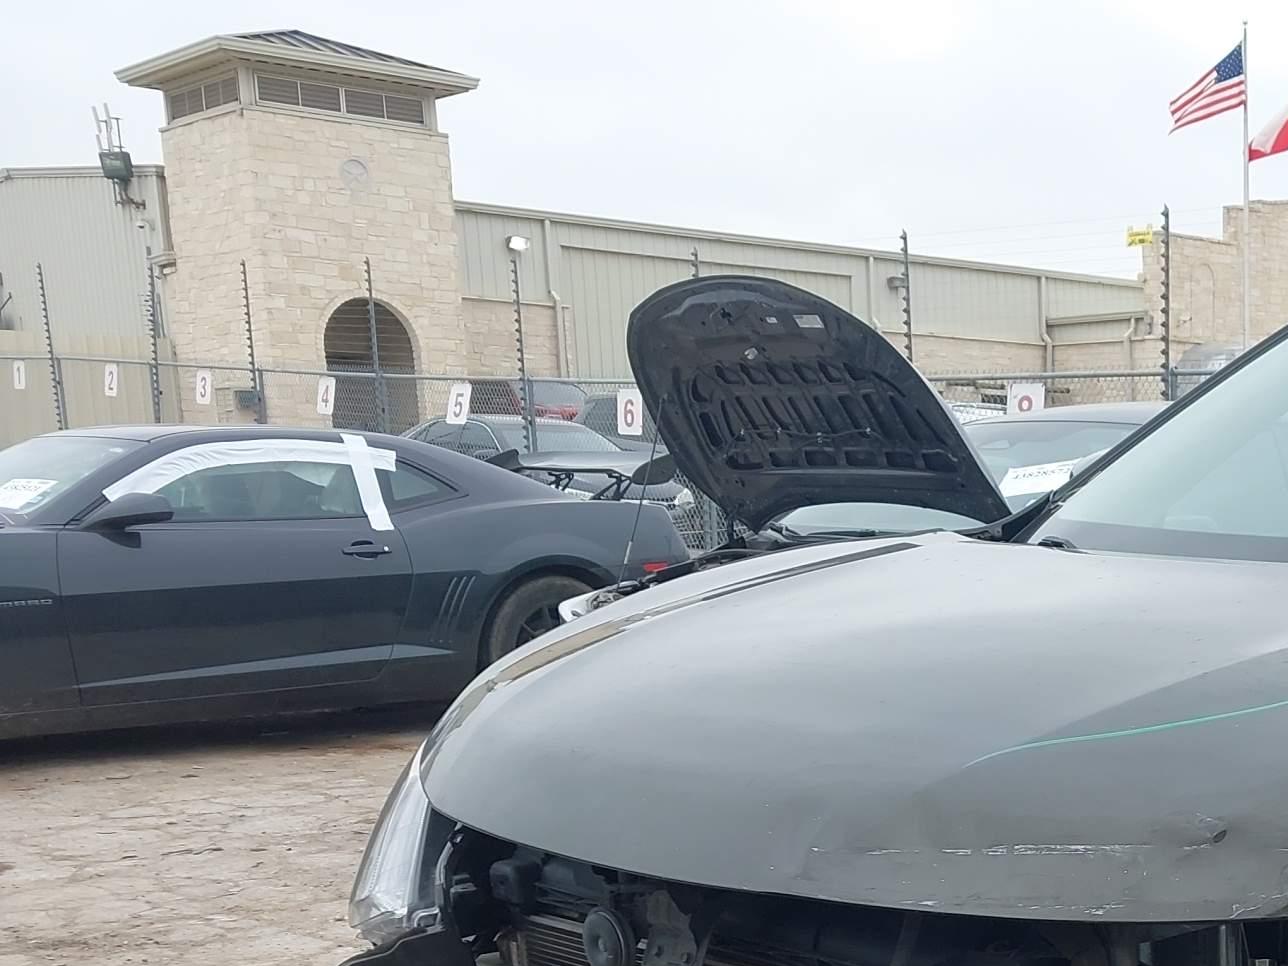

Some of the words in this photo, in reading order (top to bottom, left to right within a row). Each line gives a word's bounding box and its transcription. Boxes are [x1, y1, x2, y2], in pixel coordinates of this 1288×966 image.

[16, 366, 22, 385] 1
[107, 372, 115, 391] 2
[200, 376, 207, 398] 3
[321, 385, 330, 408] 4
[453, 392, 465, 418] 5
[623, 399, 635, 427] 6
